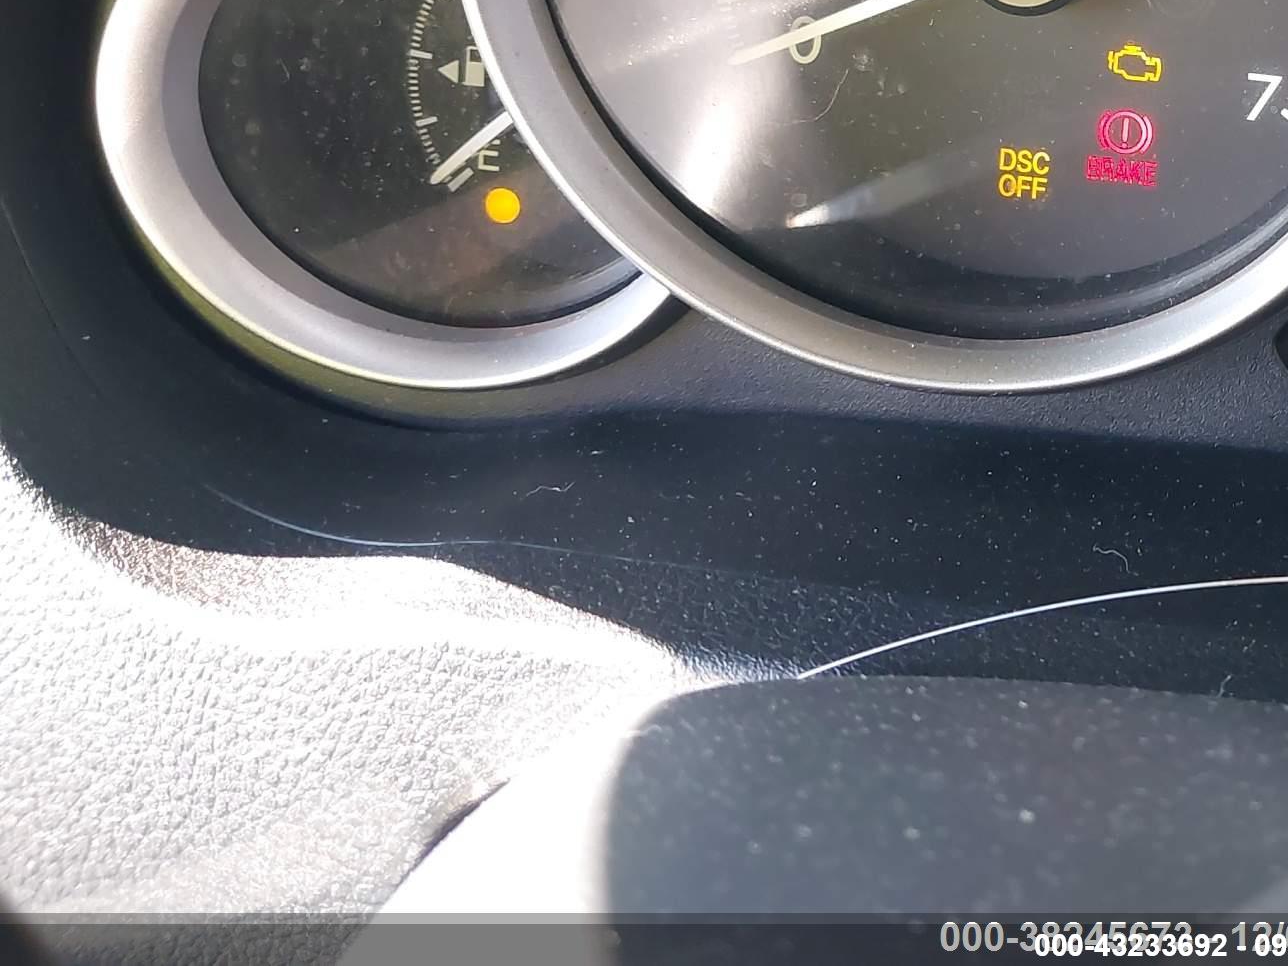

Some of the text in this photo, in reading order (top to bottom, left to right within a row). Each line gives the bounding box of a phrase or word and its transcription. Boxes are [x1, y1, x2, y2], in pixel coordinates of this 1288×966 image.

[789, 15, 822, 65] 0
[1246, 72, 1283, 121] 7
[478, 139, 501, 171] E
[999, 148, 1050, 175] DSC
[1086, 155, 1158, 186] BRAKE
[998, 174, 1048, 199] OFF
